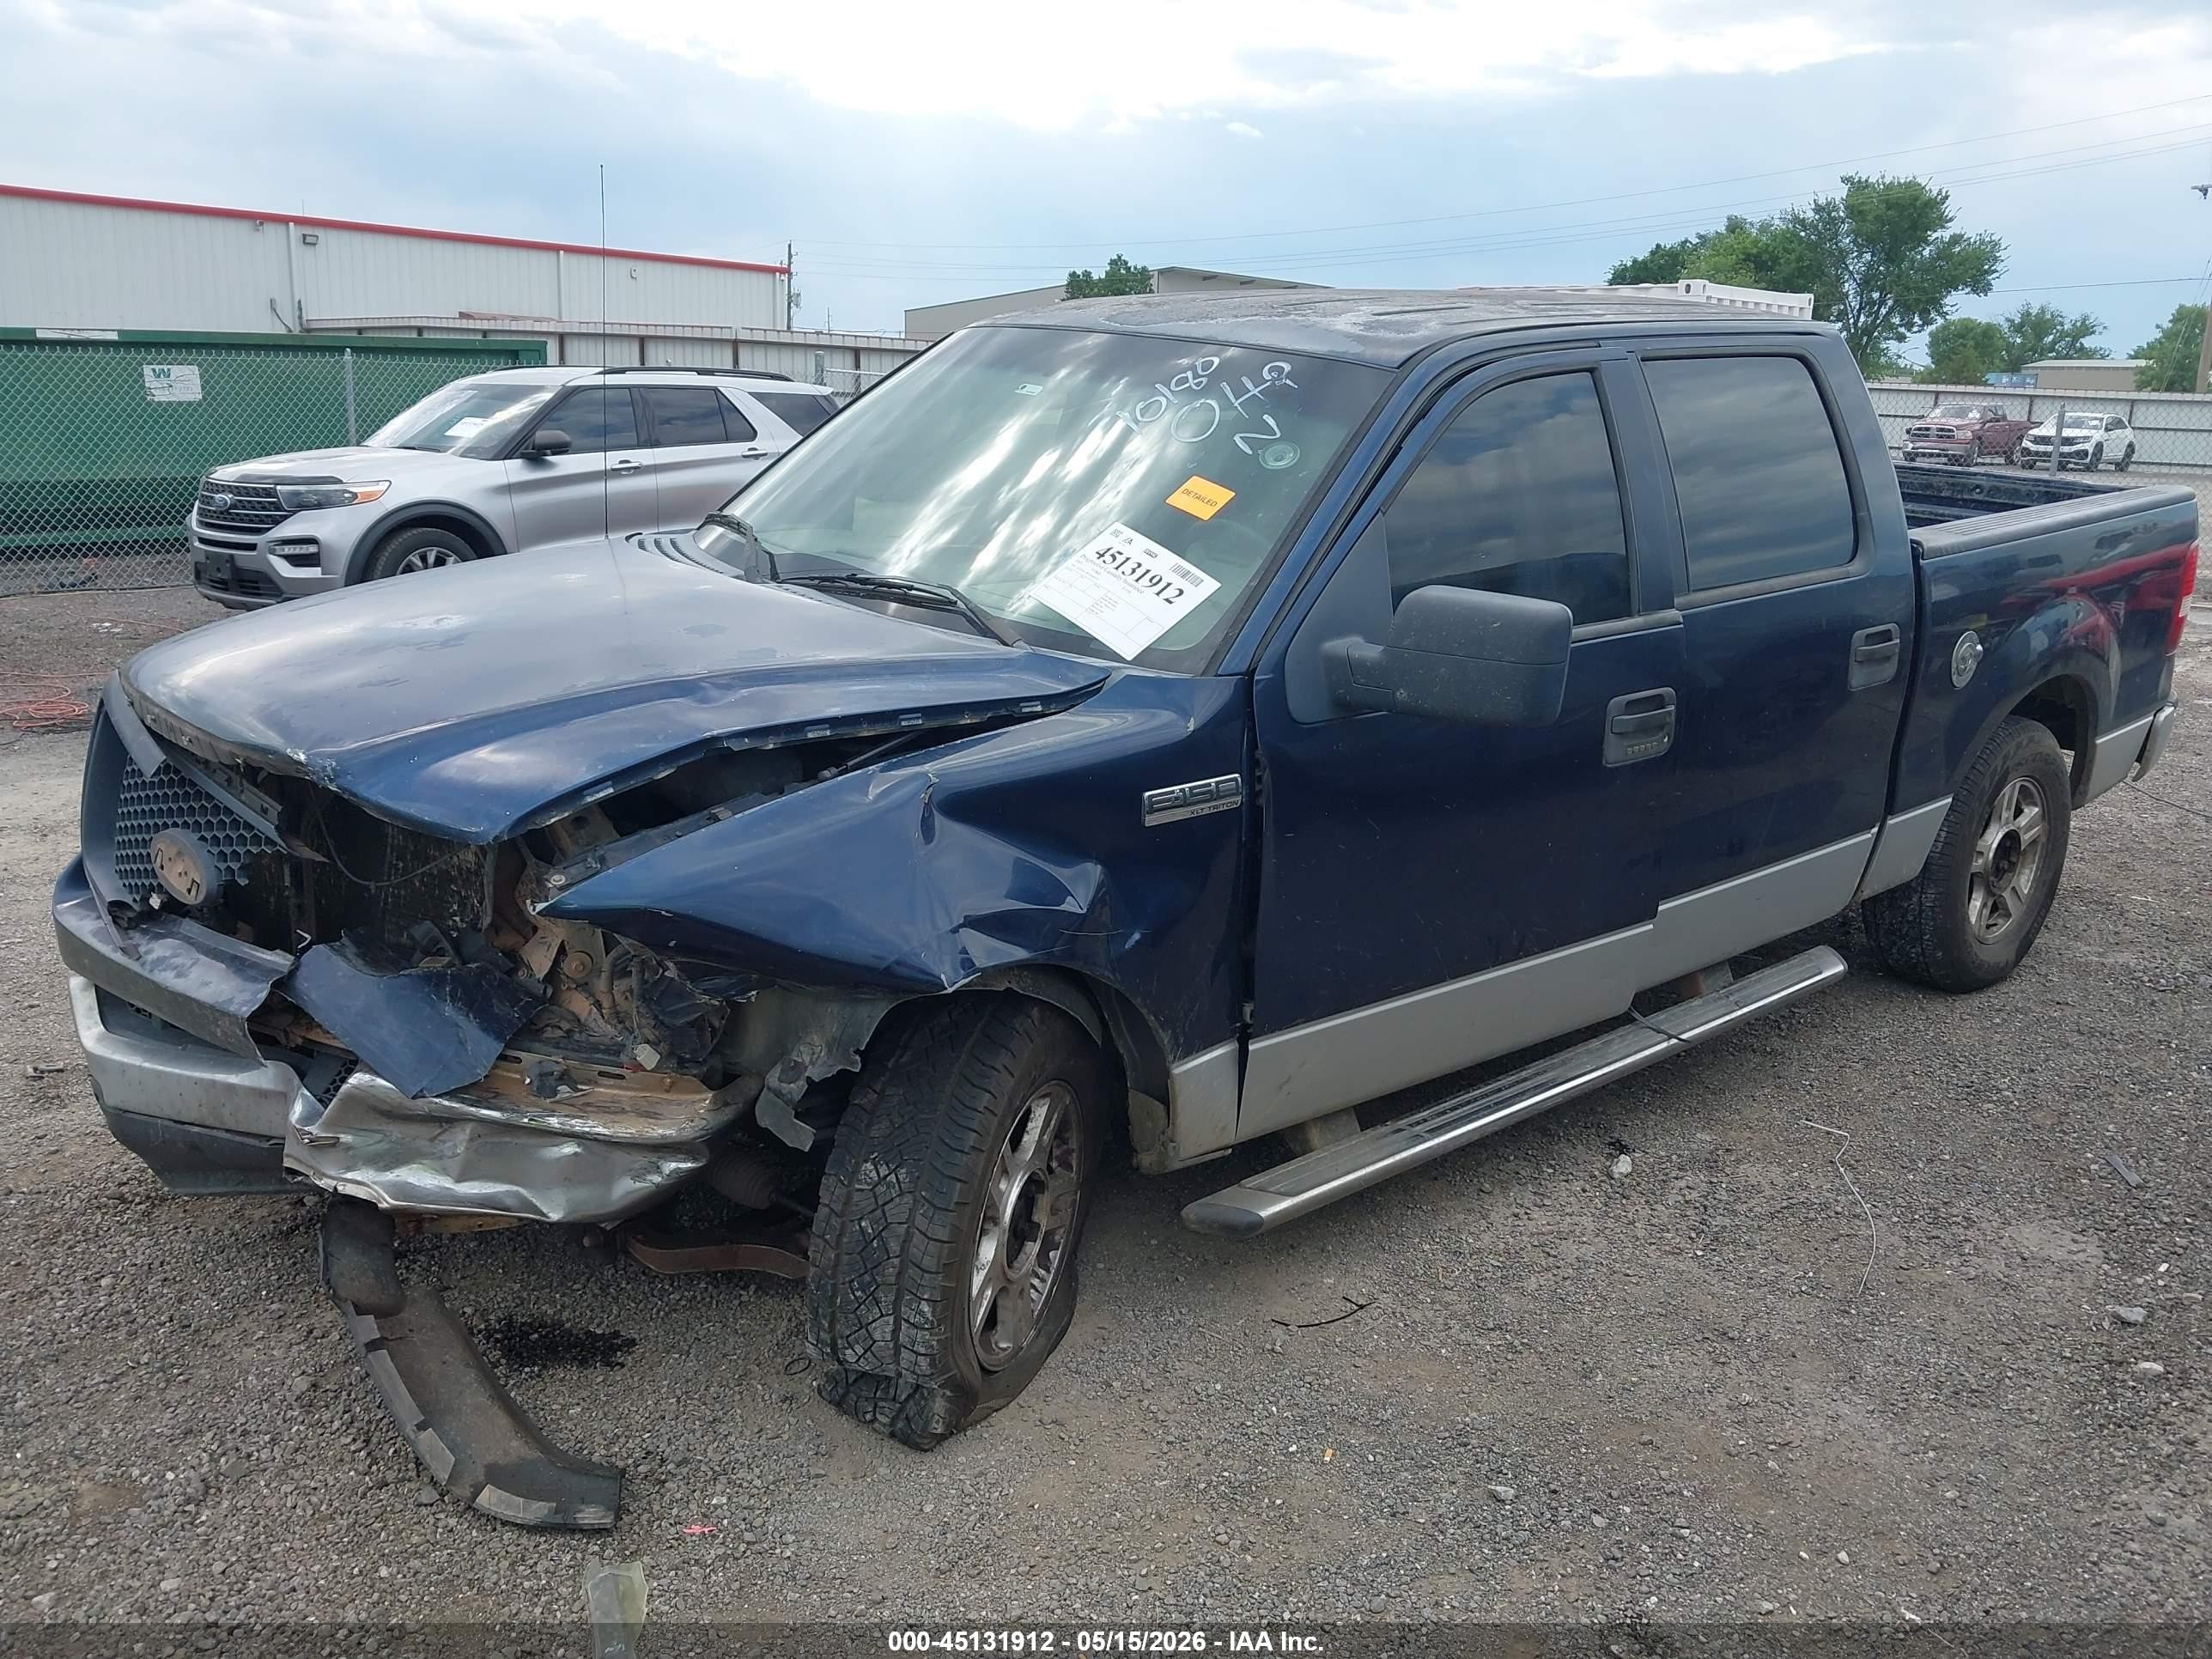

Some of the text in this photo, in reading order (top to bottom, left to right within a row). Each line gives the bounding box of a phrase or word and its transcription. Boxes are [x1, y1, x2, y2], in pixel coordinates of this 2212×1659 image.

[1182, 488, 1218, 507] DETAILED
[1095, 546, 1185, 605] 45131912
[1189, 800, 1239, 817] XLT TRITON
